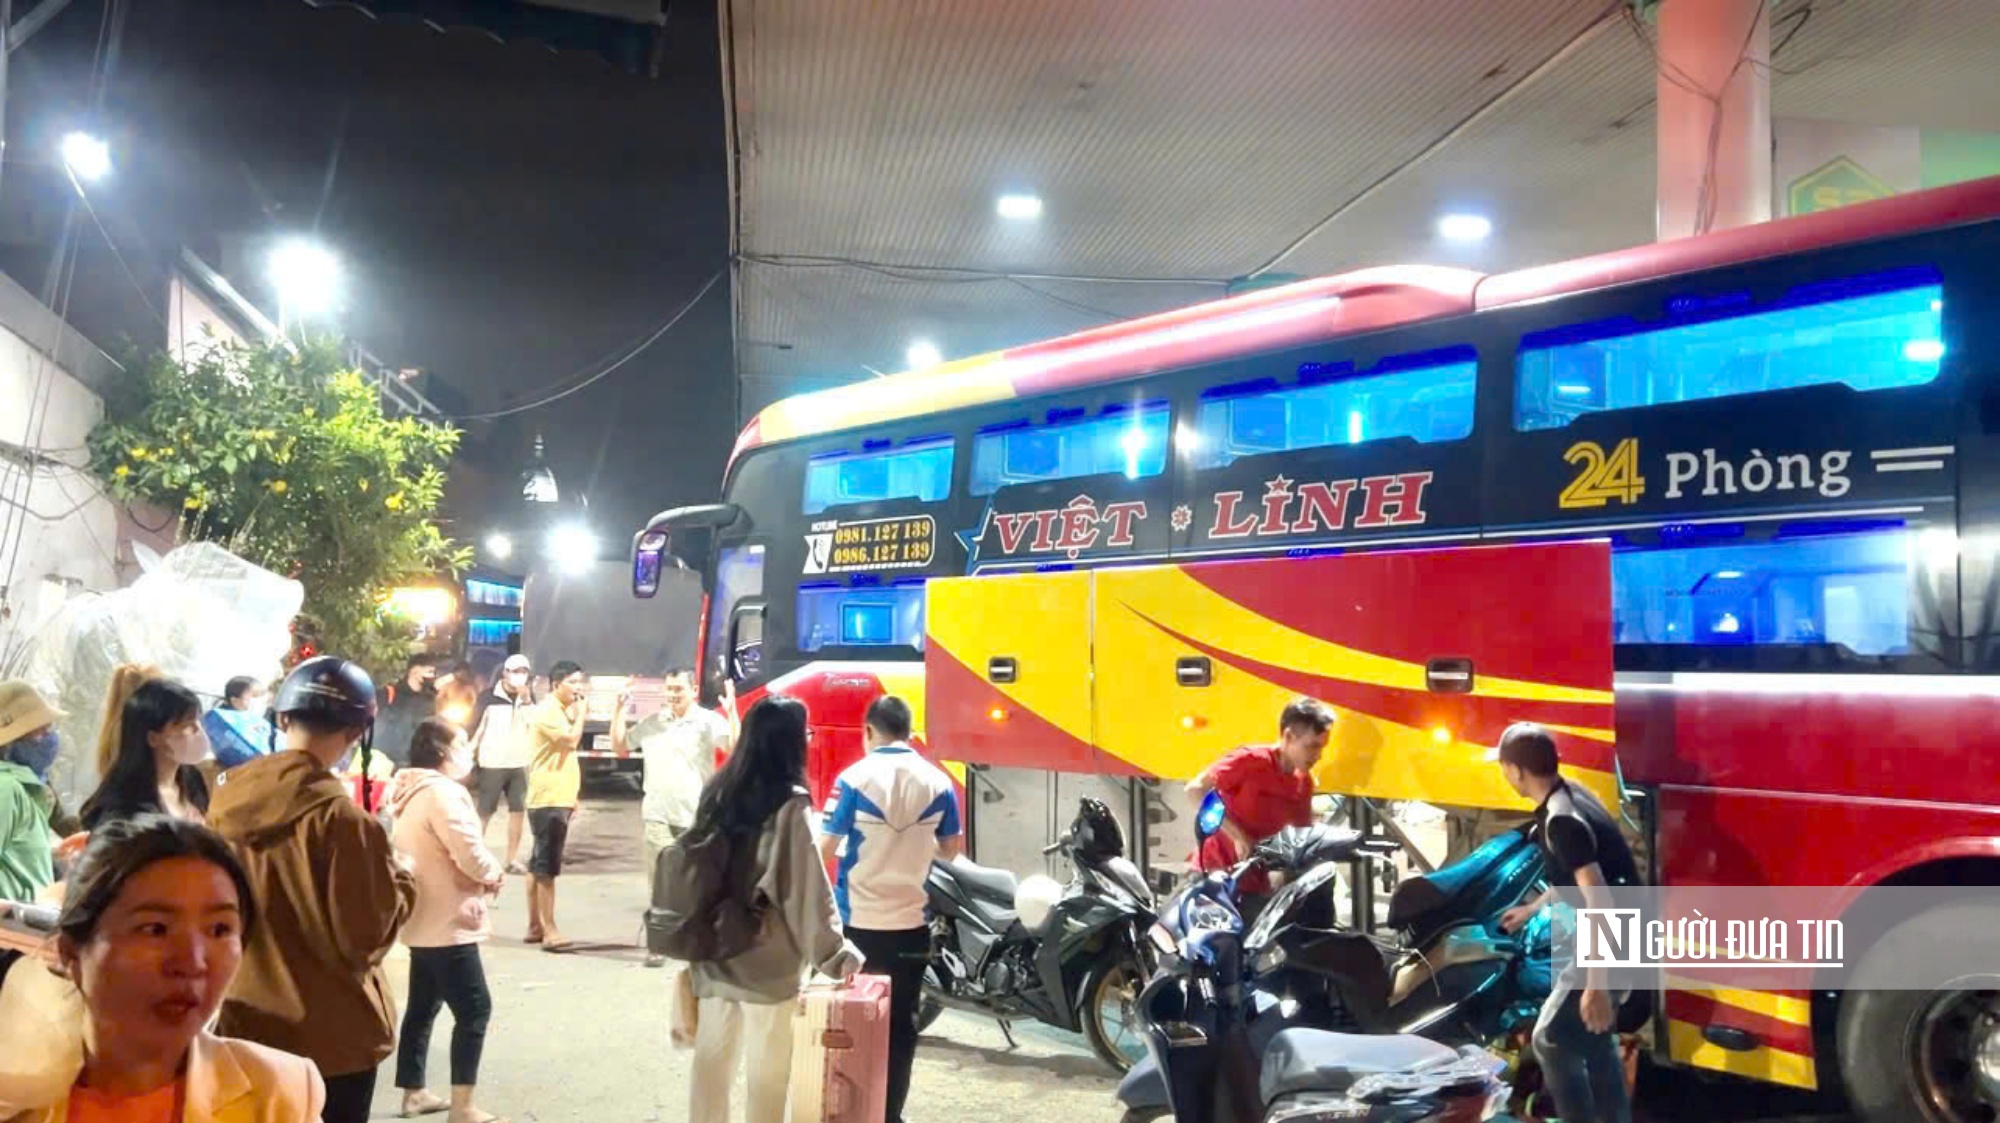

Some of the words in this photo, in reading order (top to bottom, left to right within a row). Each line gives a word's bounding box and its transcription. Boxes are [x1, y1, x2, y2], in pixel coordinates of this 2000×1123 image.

[1559, 437, 1645, 508] 24
[1665, 449, 1851, 498] Phòng
[904, 520, 931, 539] 139
[994, 494, 1147, 559] VIỆT
[1208, 471, 1433, 539] LINH
[903, 541, 930, 559] 139
